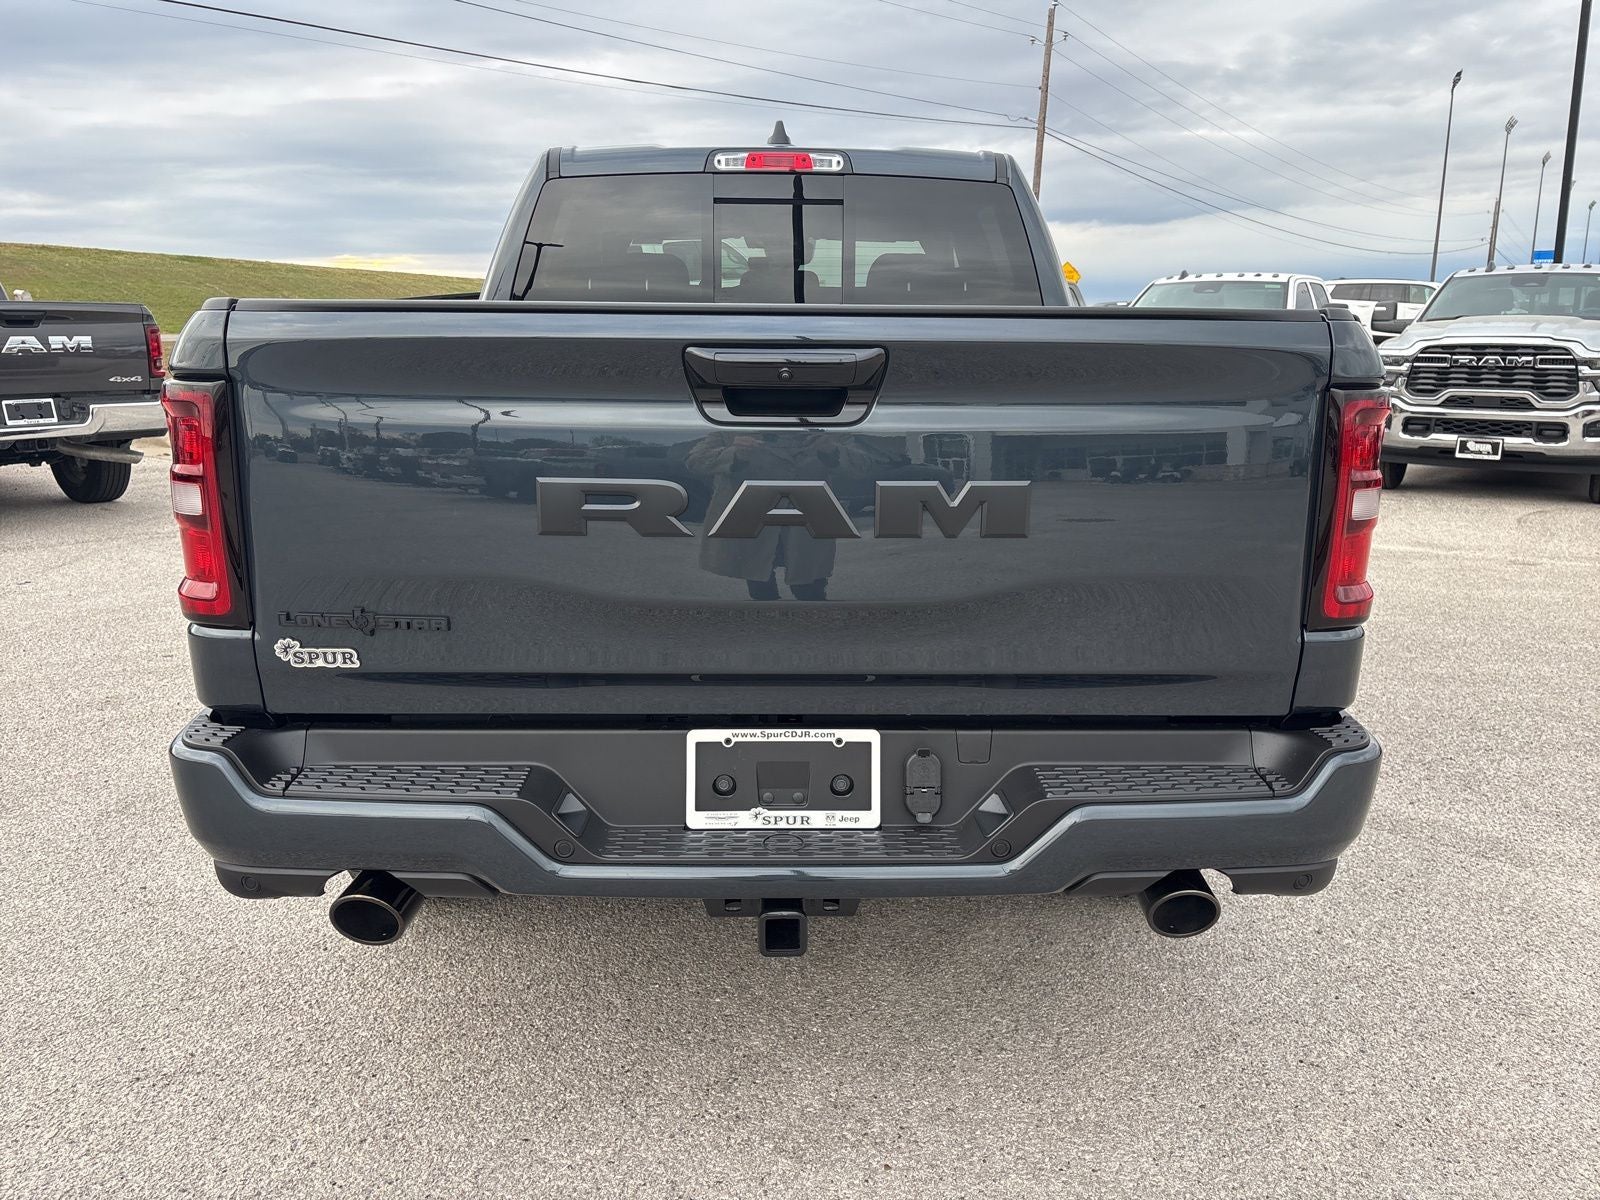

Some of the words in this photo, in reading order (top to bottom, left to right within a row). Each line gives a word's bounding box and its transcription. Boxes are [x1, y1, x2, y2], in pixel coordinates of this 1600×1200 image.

[1, 335, 94, 353] AM
[1452, 355, 1534, 367] RAM
[536, 477, 1031, 538] RAM
[277, 611, 353, 628] LONE
[374, 614, 451, 631] STAR
[292, 651, 359, 665] SPUR
[731, 730, 836, 739] www.SpurCDJR.com
[762, 815, 811, 826] SPUR
[838, 815, 860, 823] Jeep
